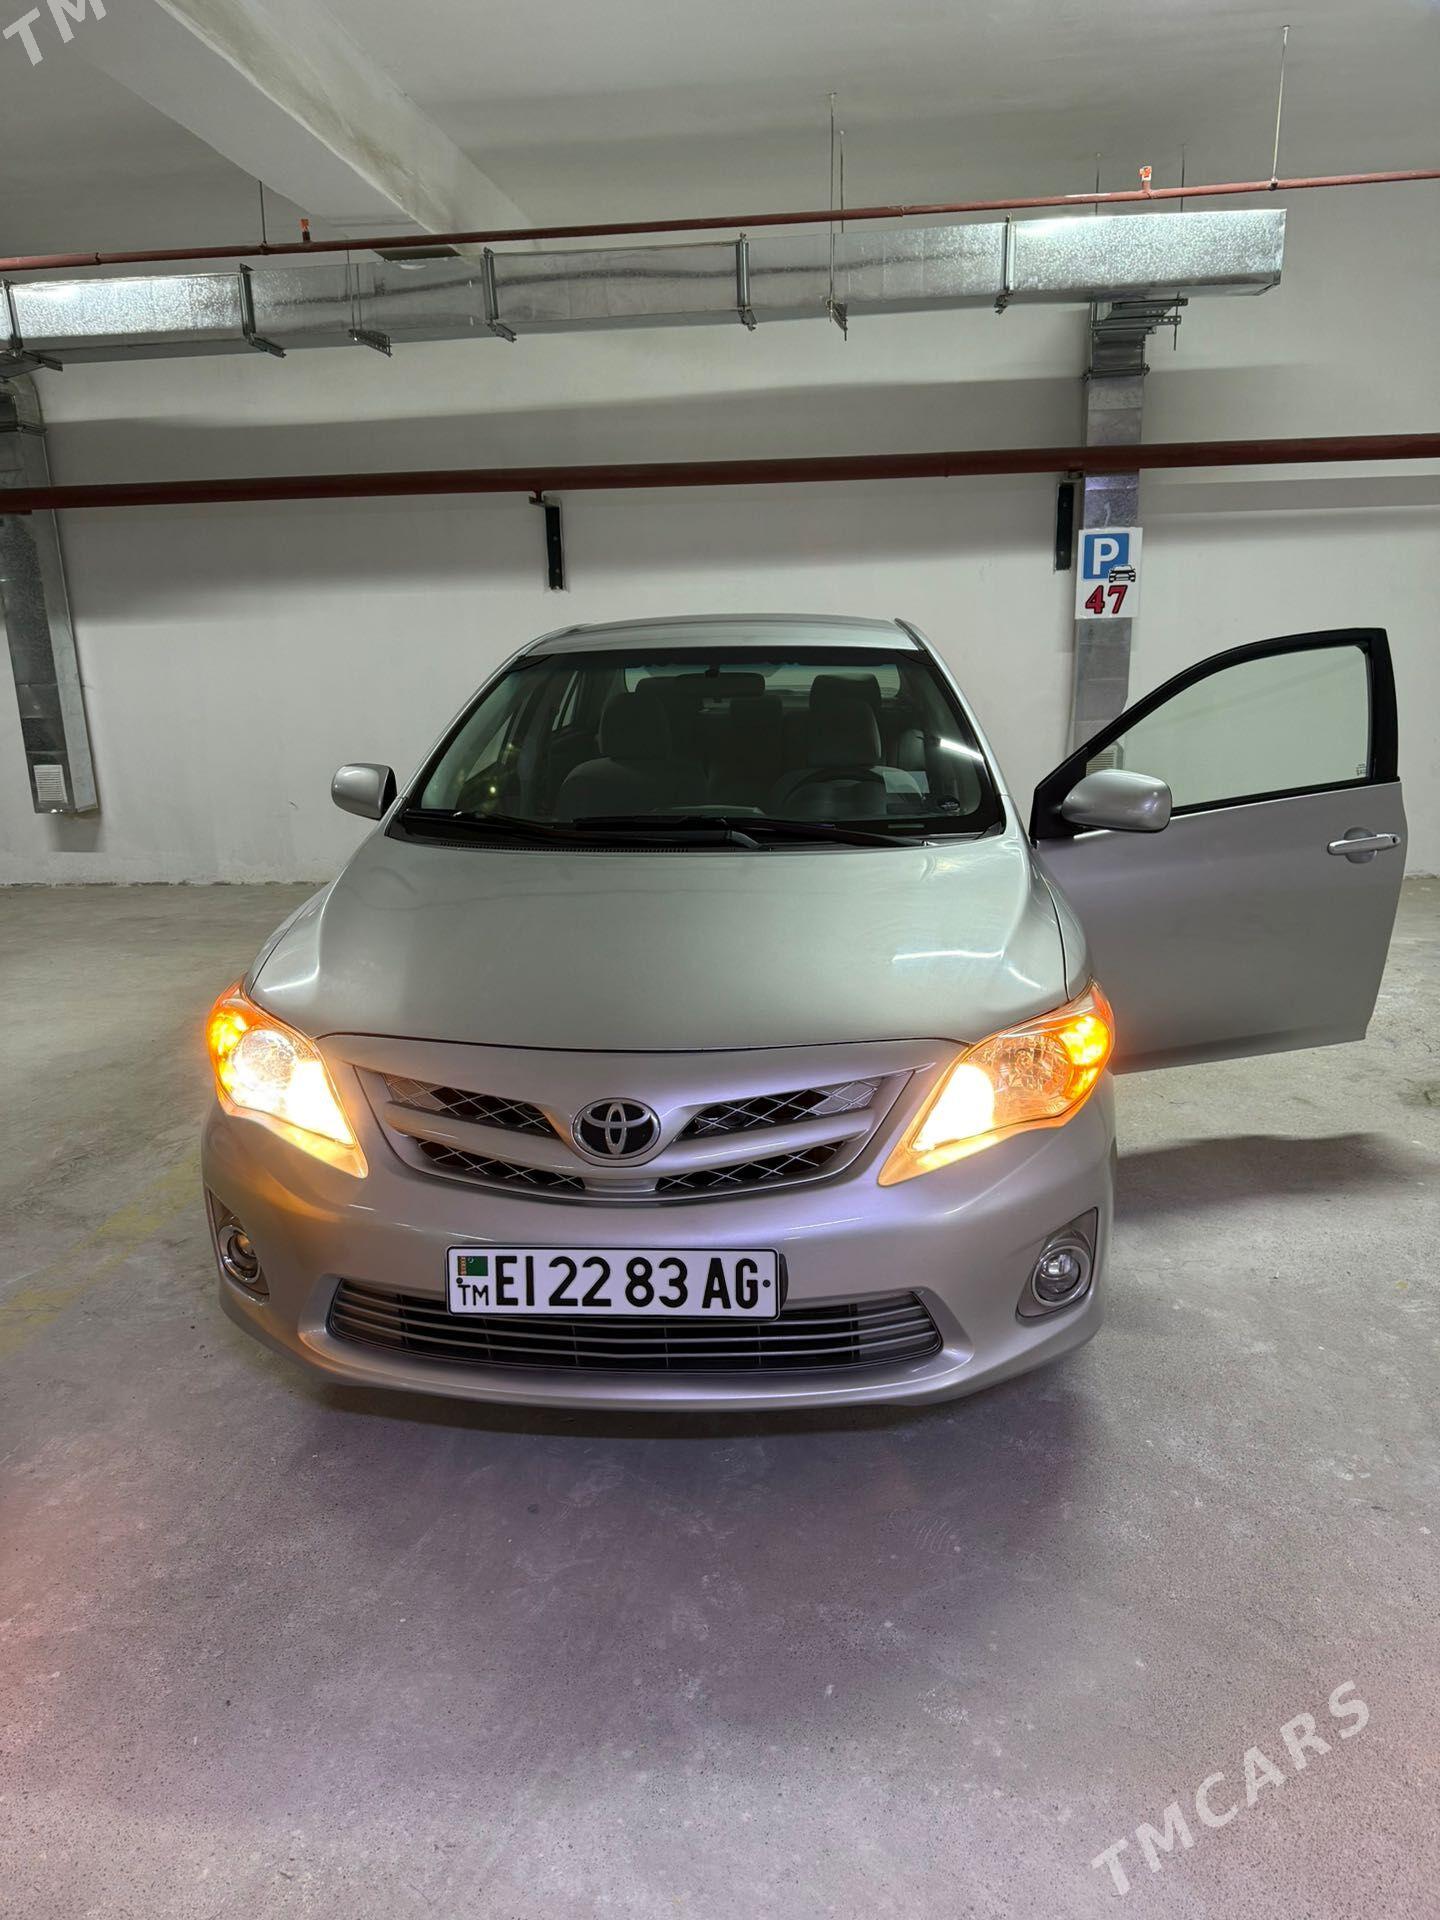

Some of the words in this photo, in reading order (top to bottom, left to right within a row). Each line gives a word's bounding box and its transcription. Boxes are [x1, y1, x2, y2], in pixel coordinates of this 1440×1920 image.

[1093, 538, 1120, 575] P
[1085, 585, 1128, 614] 47
[458, 1284, 489, 1307] TM
[702, 1258, 758, 1309] AG
